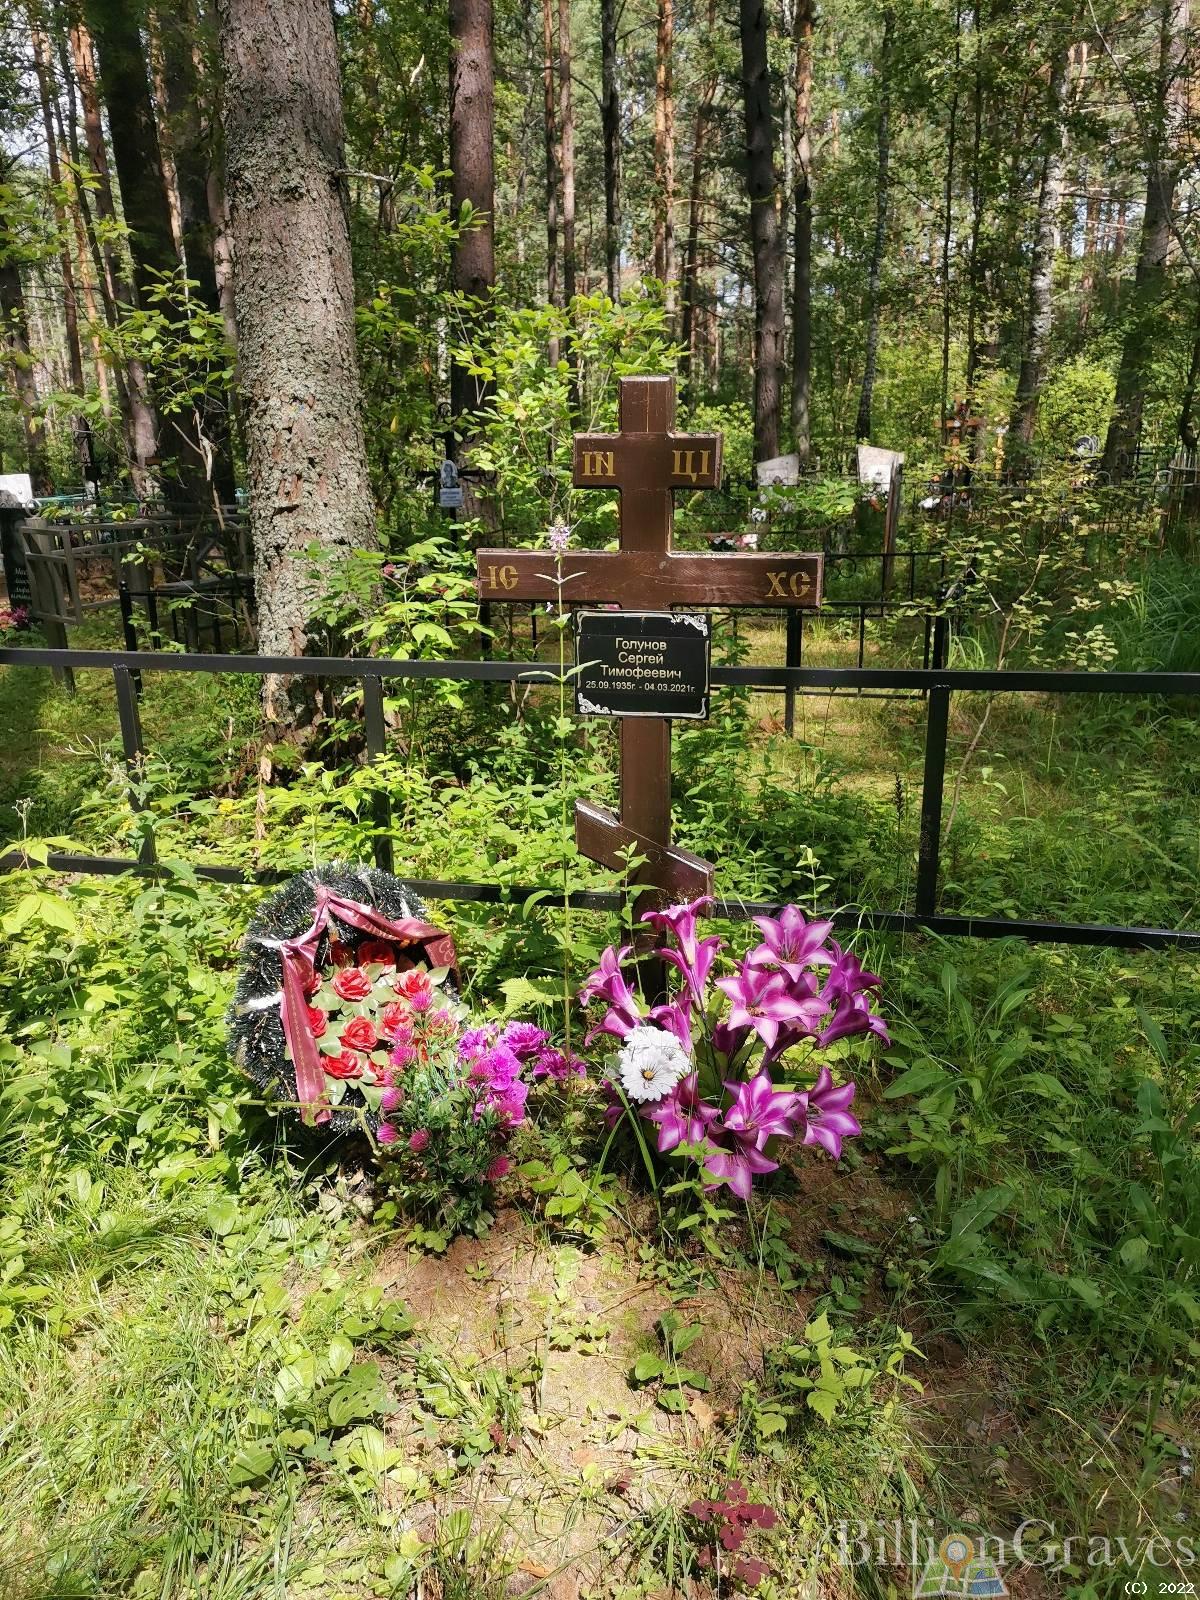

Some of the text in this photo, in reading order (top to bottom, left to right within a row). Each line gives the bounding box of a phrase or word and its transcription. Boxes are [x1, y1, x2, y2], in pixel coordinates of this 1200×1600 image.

[615, 637, 667, 652] Голунов
[618, 651, 664, 665] Сергей
[600, 664, 682, 680] Тимофеевич
[585, 680, 636, 690] 25.09.1935г.
[644, 682, 696, 693] 04.03.2021г.
